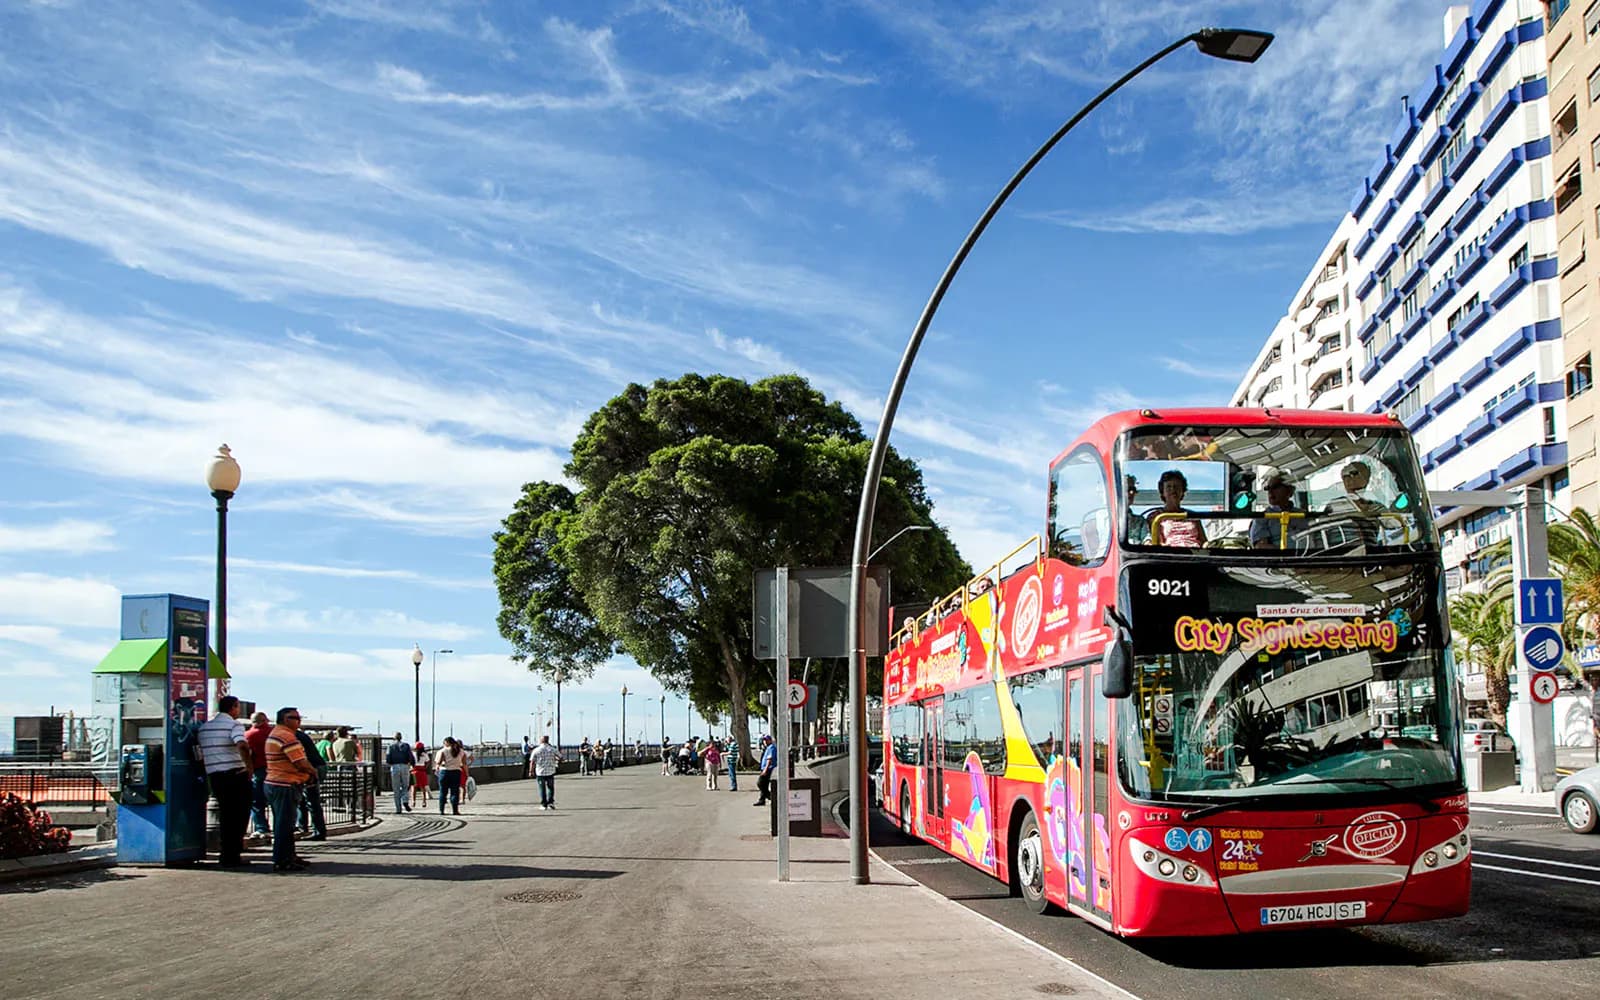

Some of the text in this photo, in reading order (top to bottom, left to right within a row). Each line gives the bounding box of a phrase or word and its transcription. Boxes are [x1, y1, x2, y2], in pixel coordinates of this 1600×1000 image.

[1148, 579, 1190, 596] 9021
[1260, 606, 1363, 615] Santa Cruz de Tenerife
[1175, 616, 1397, 654] City Sightseeing
[1355, 828, 1394, 843] OFICIAL
[1222, 839, 1244, 861] 24
[1270, 908, 1303, 922] 6704
[1307, 906, 1332, 919] HCJ
